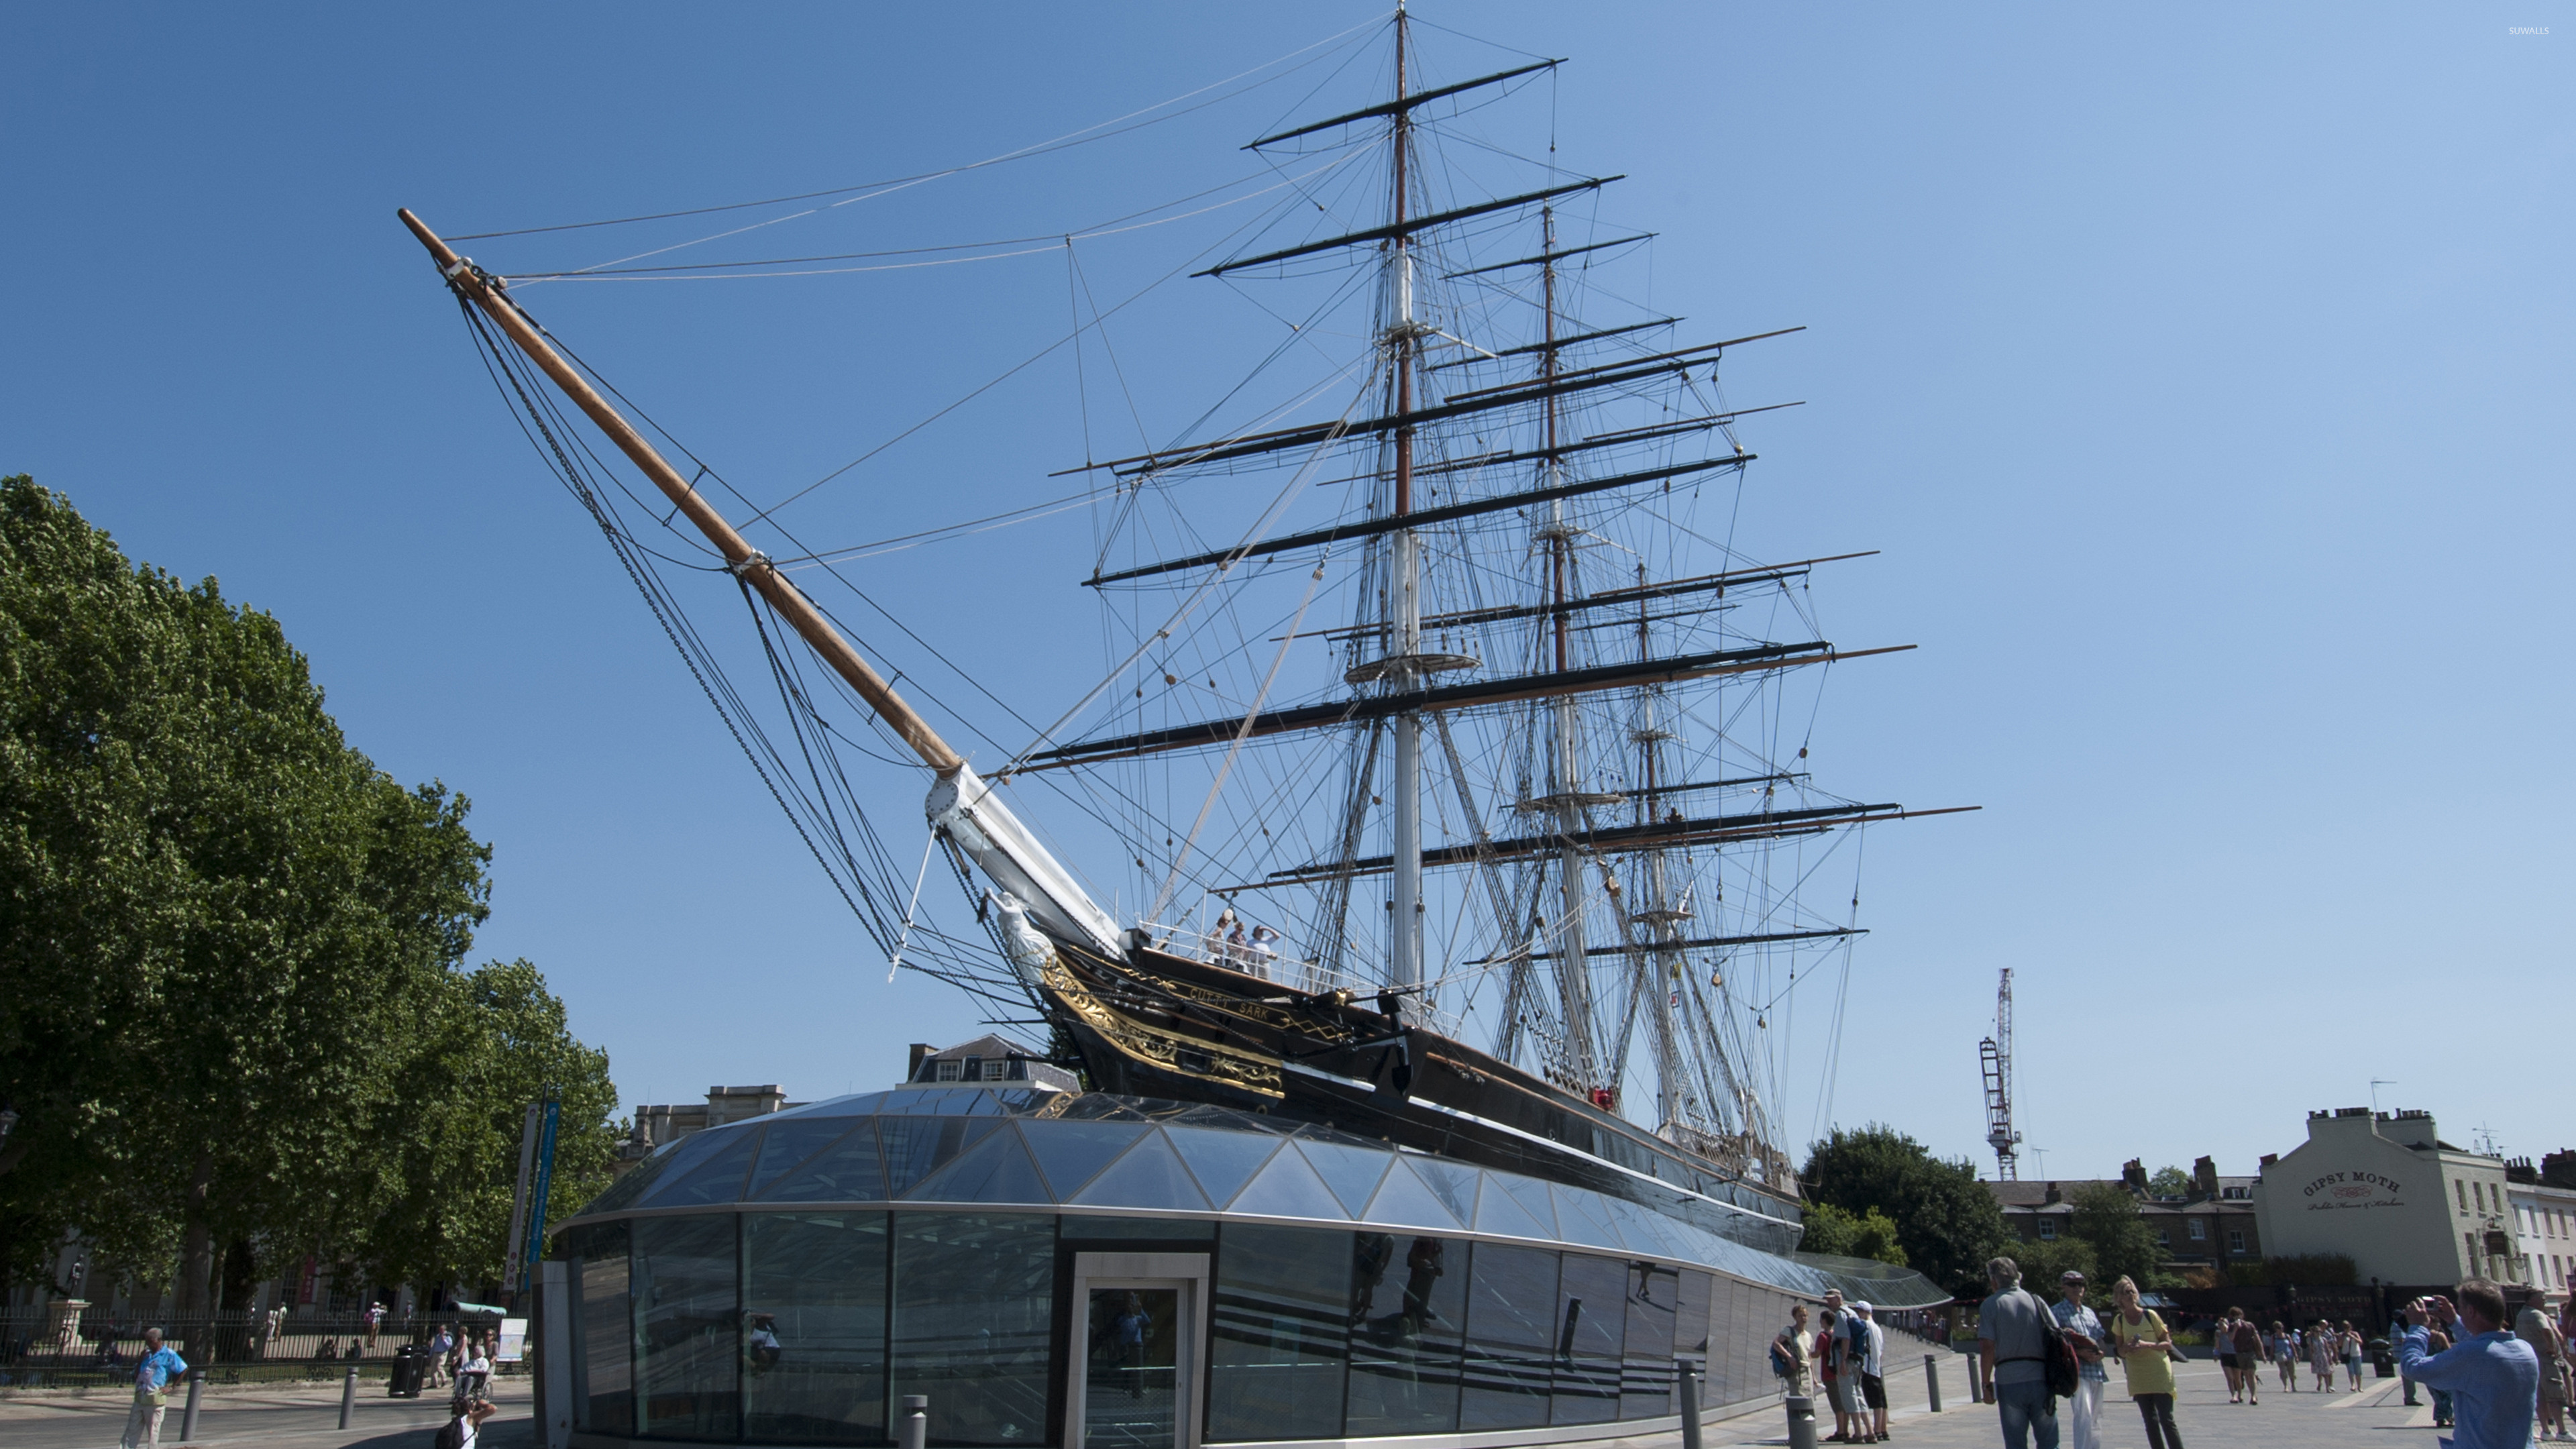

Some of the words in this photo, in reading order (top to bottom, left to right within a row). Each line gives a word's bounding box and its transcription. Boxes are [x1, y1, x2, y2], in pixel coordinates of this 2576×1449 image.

[1239, 1002, 1269, 1020] SARK
[2304, 1172, 2345, 1197] GIPSY
[2352, 1171, 2401, 1193] MOTH
